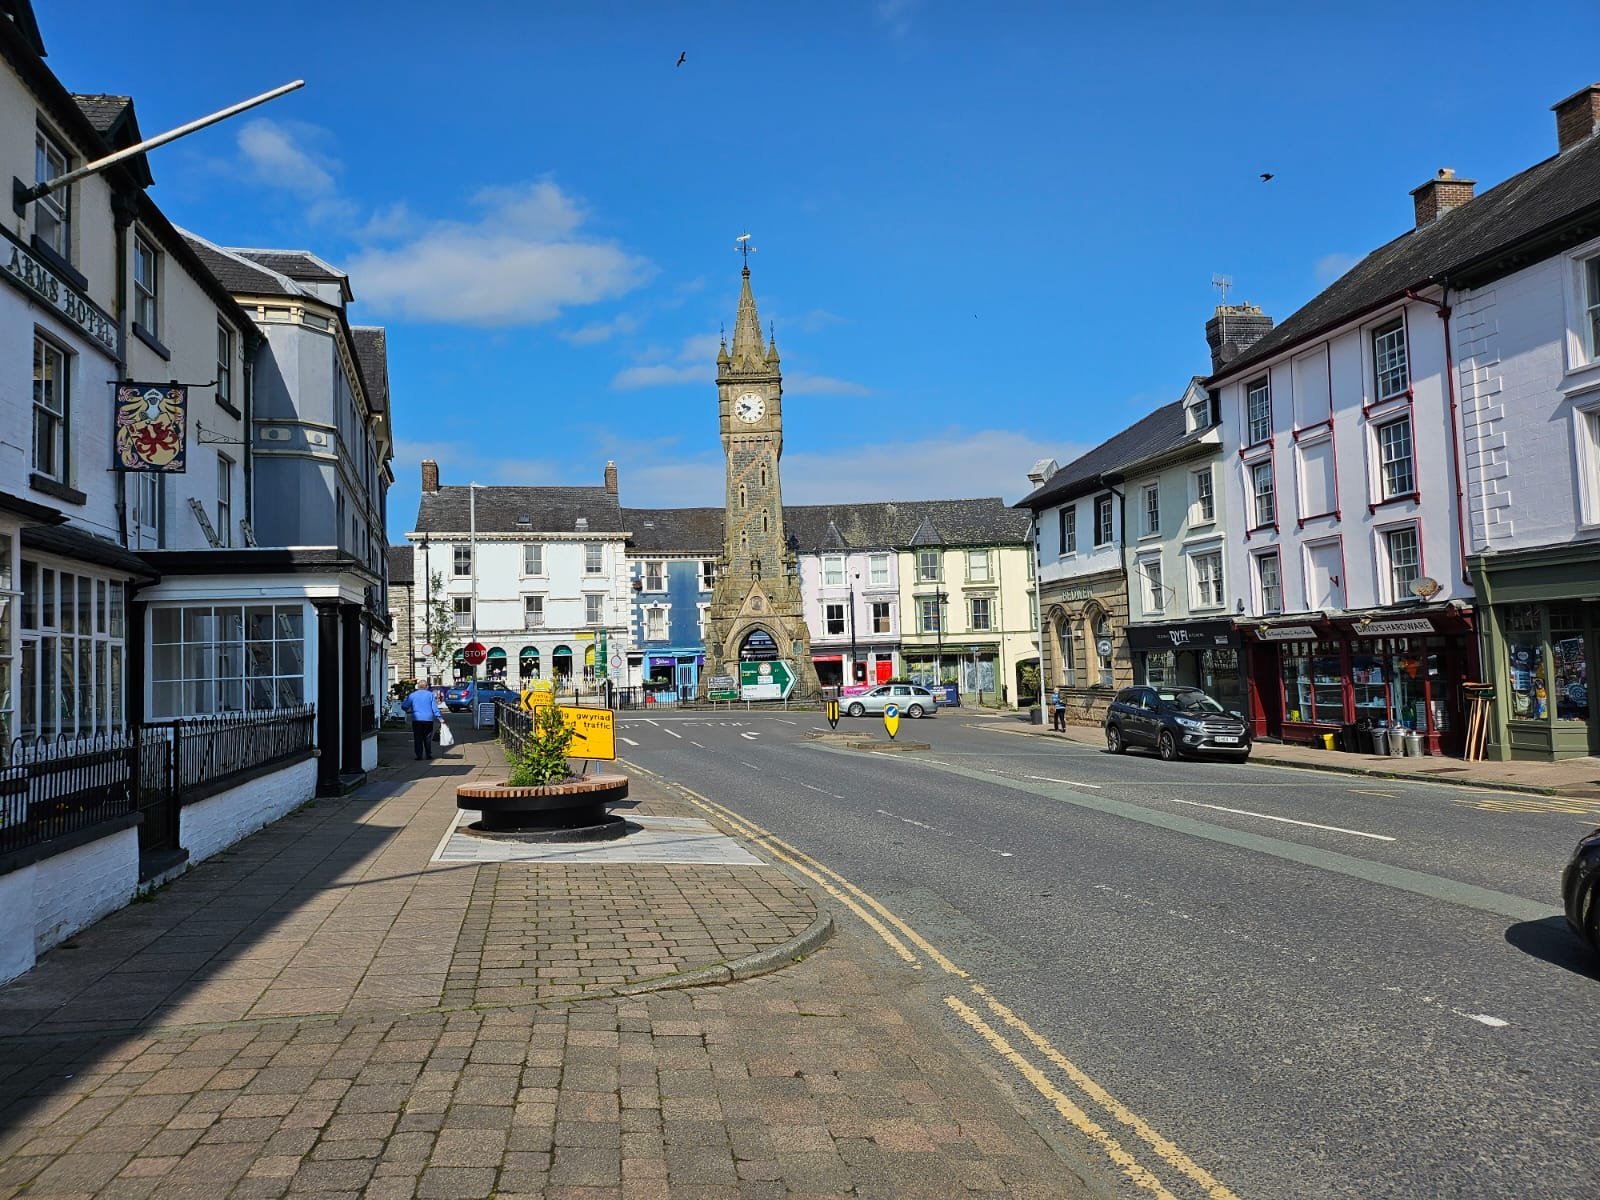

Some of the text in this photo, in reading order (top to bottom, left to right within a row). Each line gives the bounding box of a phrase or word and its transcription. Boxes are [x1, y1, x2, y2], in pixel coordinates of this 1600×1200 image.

[7, 246, 113, 347] ARMS HOTEL
[1384, 621, 1431, 632] HARDWARE
[1169, 629, 1190, 646] DYFI
[464, 650, 486, 658] STOP
[576, 713, 611, 721] gwyriad
[583, 721, 611, 730] traffic
